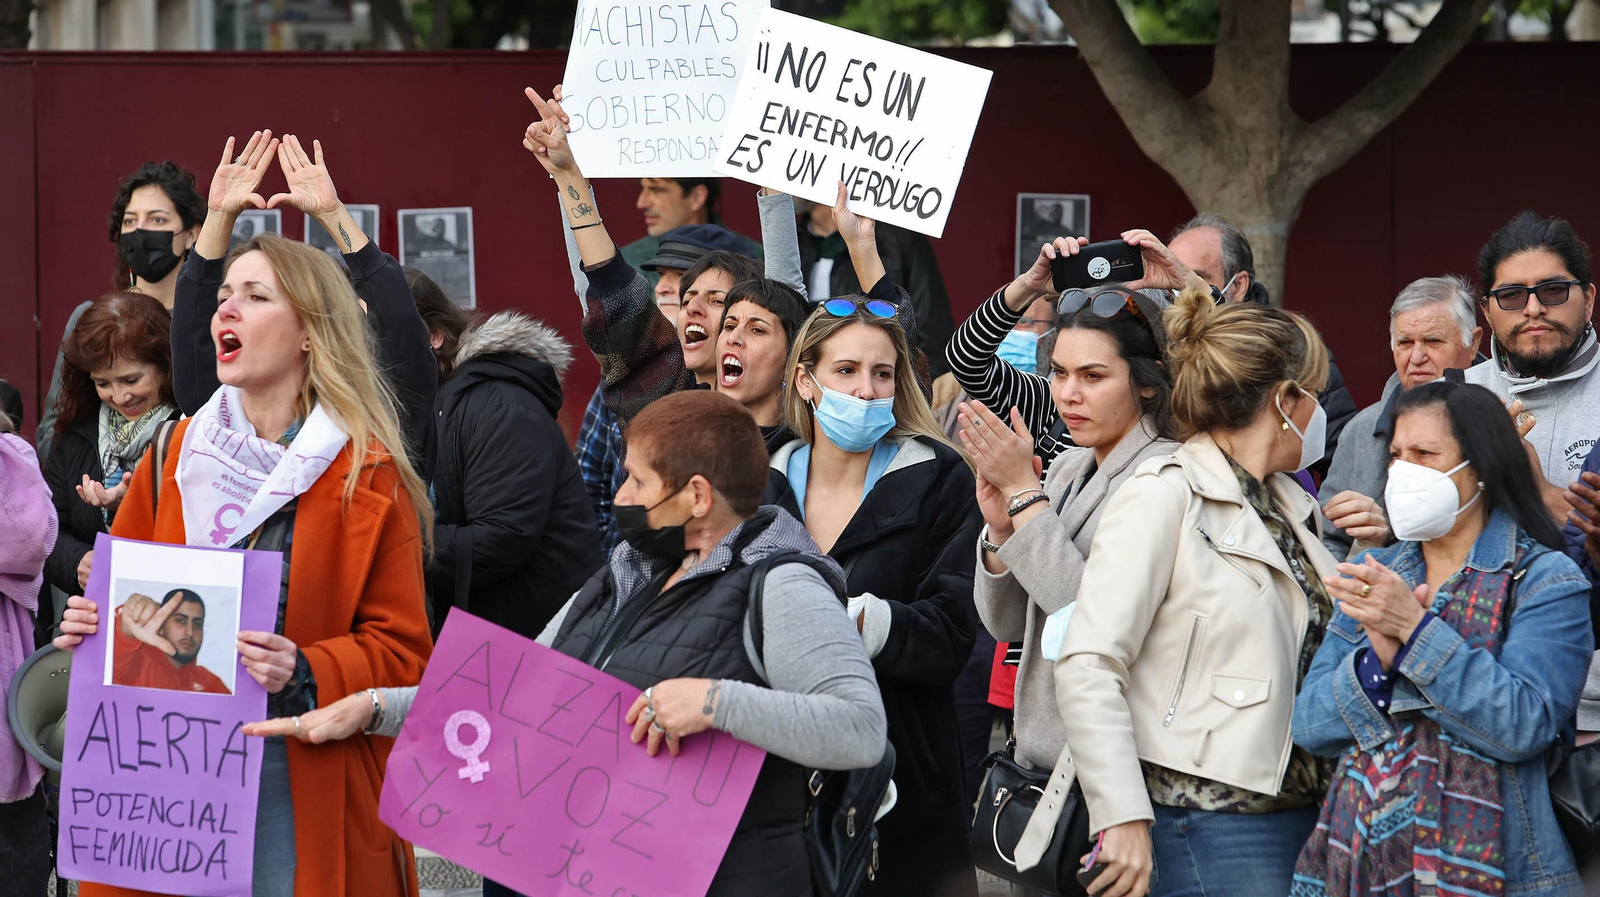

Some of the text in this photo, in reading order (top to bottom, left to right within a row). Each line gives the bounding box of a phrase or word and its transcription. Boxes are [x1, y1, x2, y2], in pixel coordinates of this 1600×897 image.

[577, 2, 738, 47] MACHISTAS
[596, 57, 737, 82] CULPABLES
[836, 58, 877, 108] ES
[883, 69, 926, 121] UN
[559, 93, 726, 133] GOBIERNO
[759, 101, 924, 172] ENFERMO!!
[618, 136, 723, 165] RESPONSA
[727, 133, 943, 219] ES UN VERDUGO
[436, 640, 622, 766] ALZA
[78, 701, 248, 788] ALERTA
[71, 788, 237, 834] POTENCIAL
[400, 757, 452, 828] Yo
[545, 838, 594, 896] te
[513, 737, 670, 860] VOZ
[70, 825, 228, 880] FEMINICIDA
